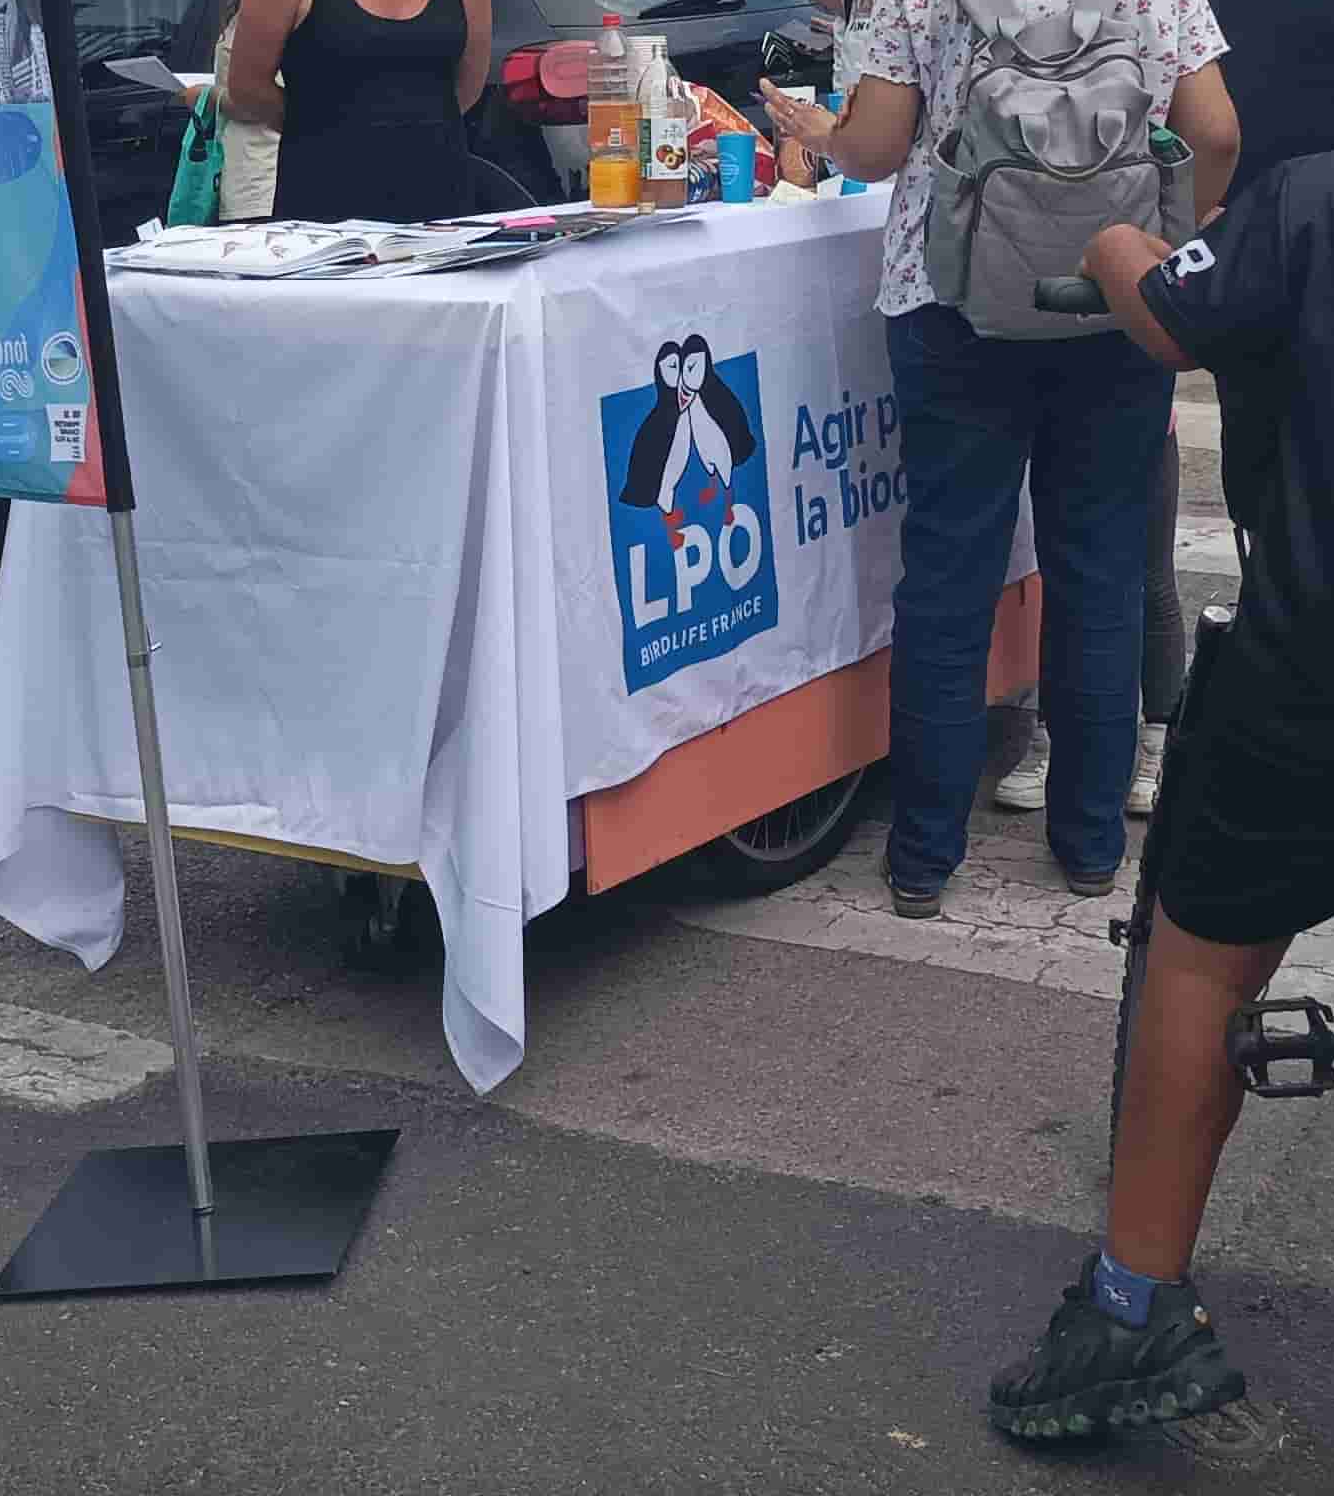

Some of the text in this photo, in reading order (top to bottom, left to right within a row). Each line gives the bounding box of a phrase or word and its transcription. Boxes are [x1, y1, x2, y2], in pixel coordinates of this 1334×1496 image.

[792, 389, 867, 470] Agir
[794, 483, 828, 547] la
[629, 502, 764, 629] LPO
[640, 594, 764, 667] BIRDLIFE FRANCE
